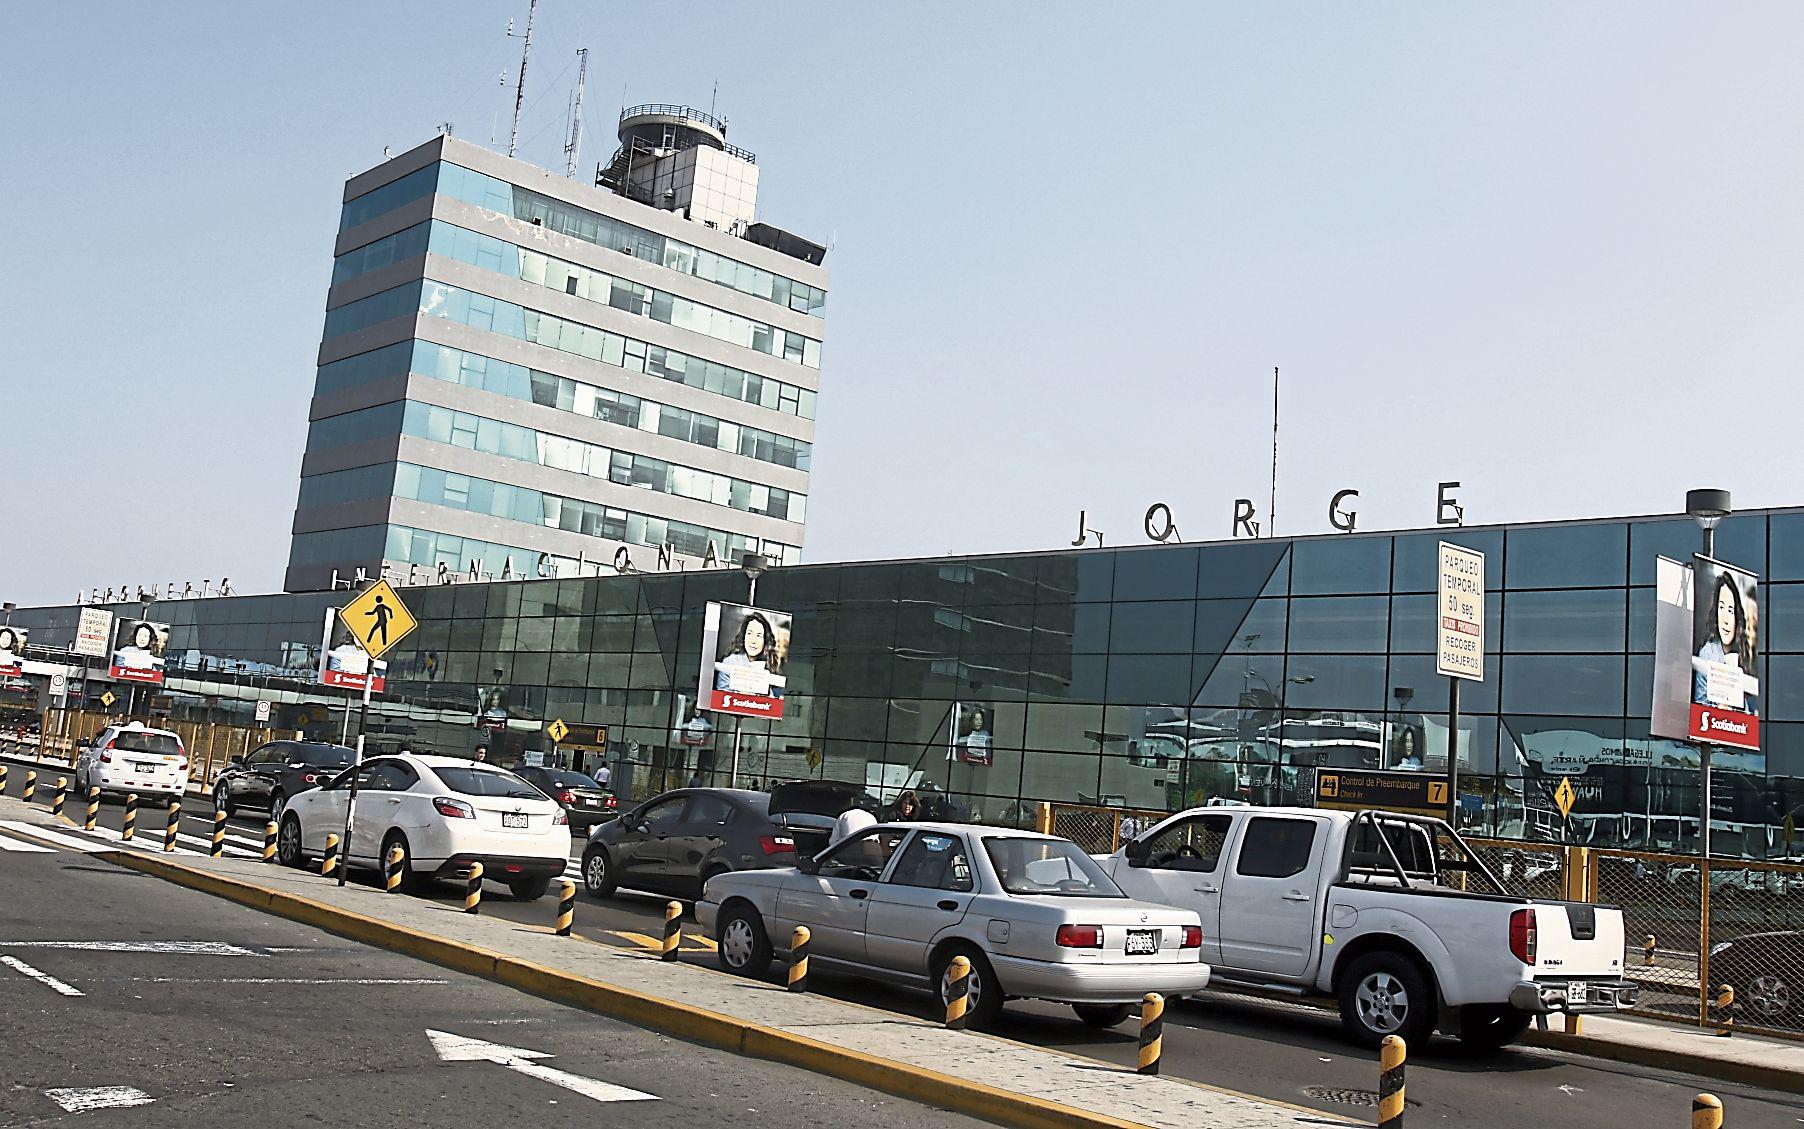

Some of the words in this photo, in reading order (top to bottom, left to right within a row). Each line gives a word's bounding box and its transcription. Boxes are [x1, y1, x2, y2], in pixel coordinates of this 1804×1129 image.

[1072, 482, 1460, 547] JORGE
[1445, 554, 1479, 576] PARQUEO
[1443, 573, 1480, 596] TEMPORAL
[1445, 635, 1476, 652] RECOGER
[1443, 652, 1479, 669] PASAJEROS
[732, 698, 771, 711] Scotiabank
[1711, 717, 1748, 735] Scotiabank
[1341, 775, 1364, 787] Control
[1366, 777, 1375, 787] de
[1376, 778, 1420, 791] Preembarque
[1433, 784, 1443, 801] 7
